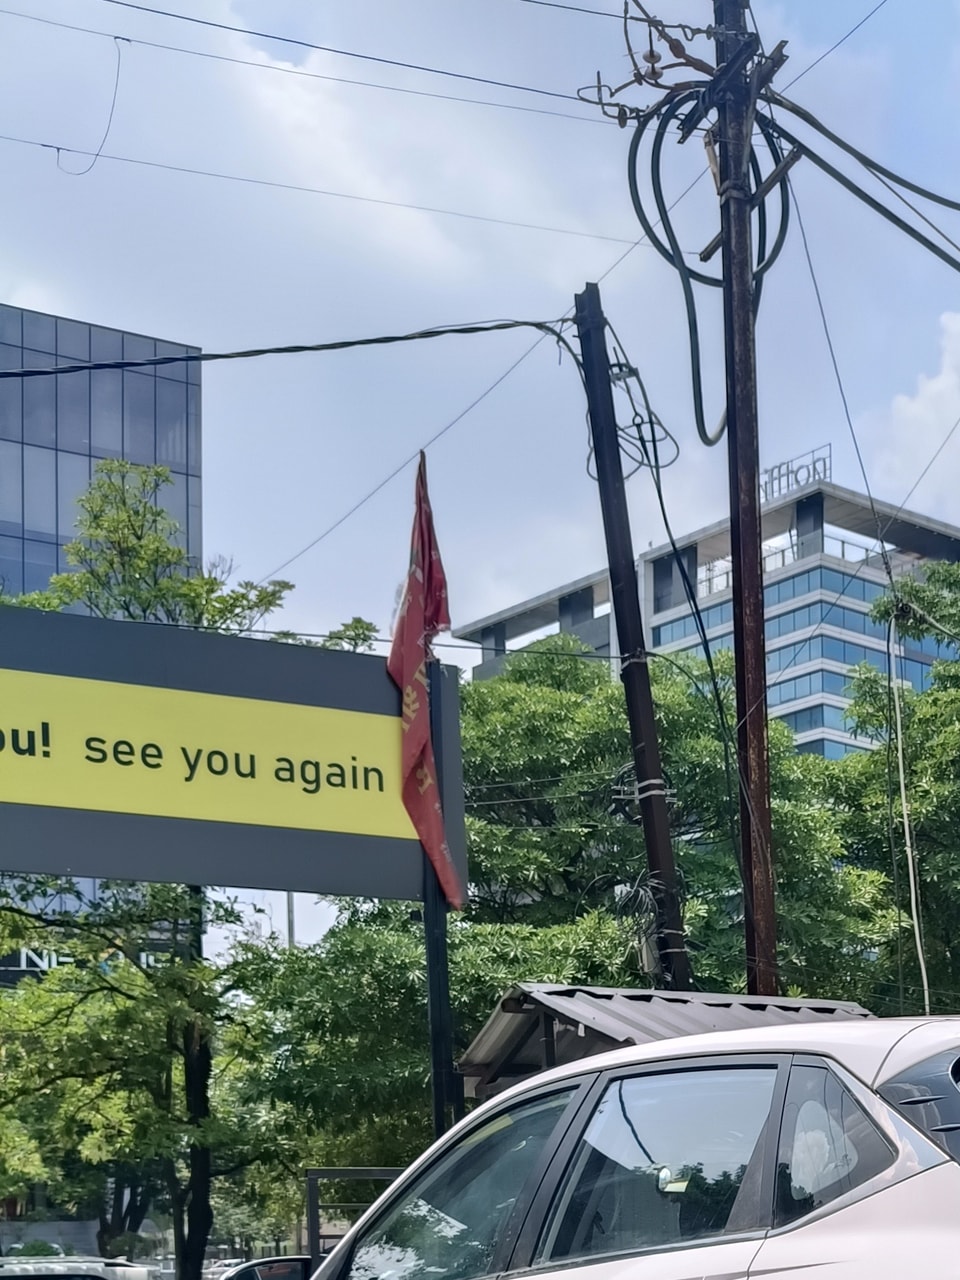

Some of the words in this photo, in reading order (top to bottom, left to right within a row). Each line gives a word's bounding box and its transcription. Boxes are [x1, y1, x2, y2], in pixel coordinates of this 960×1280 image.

[0, 721, 51, 758] u!
[84, 736, 163, 769] see
[180, 746, 256, 782] you
[273, 755, 384, 795] again
